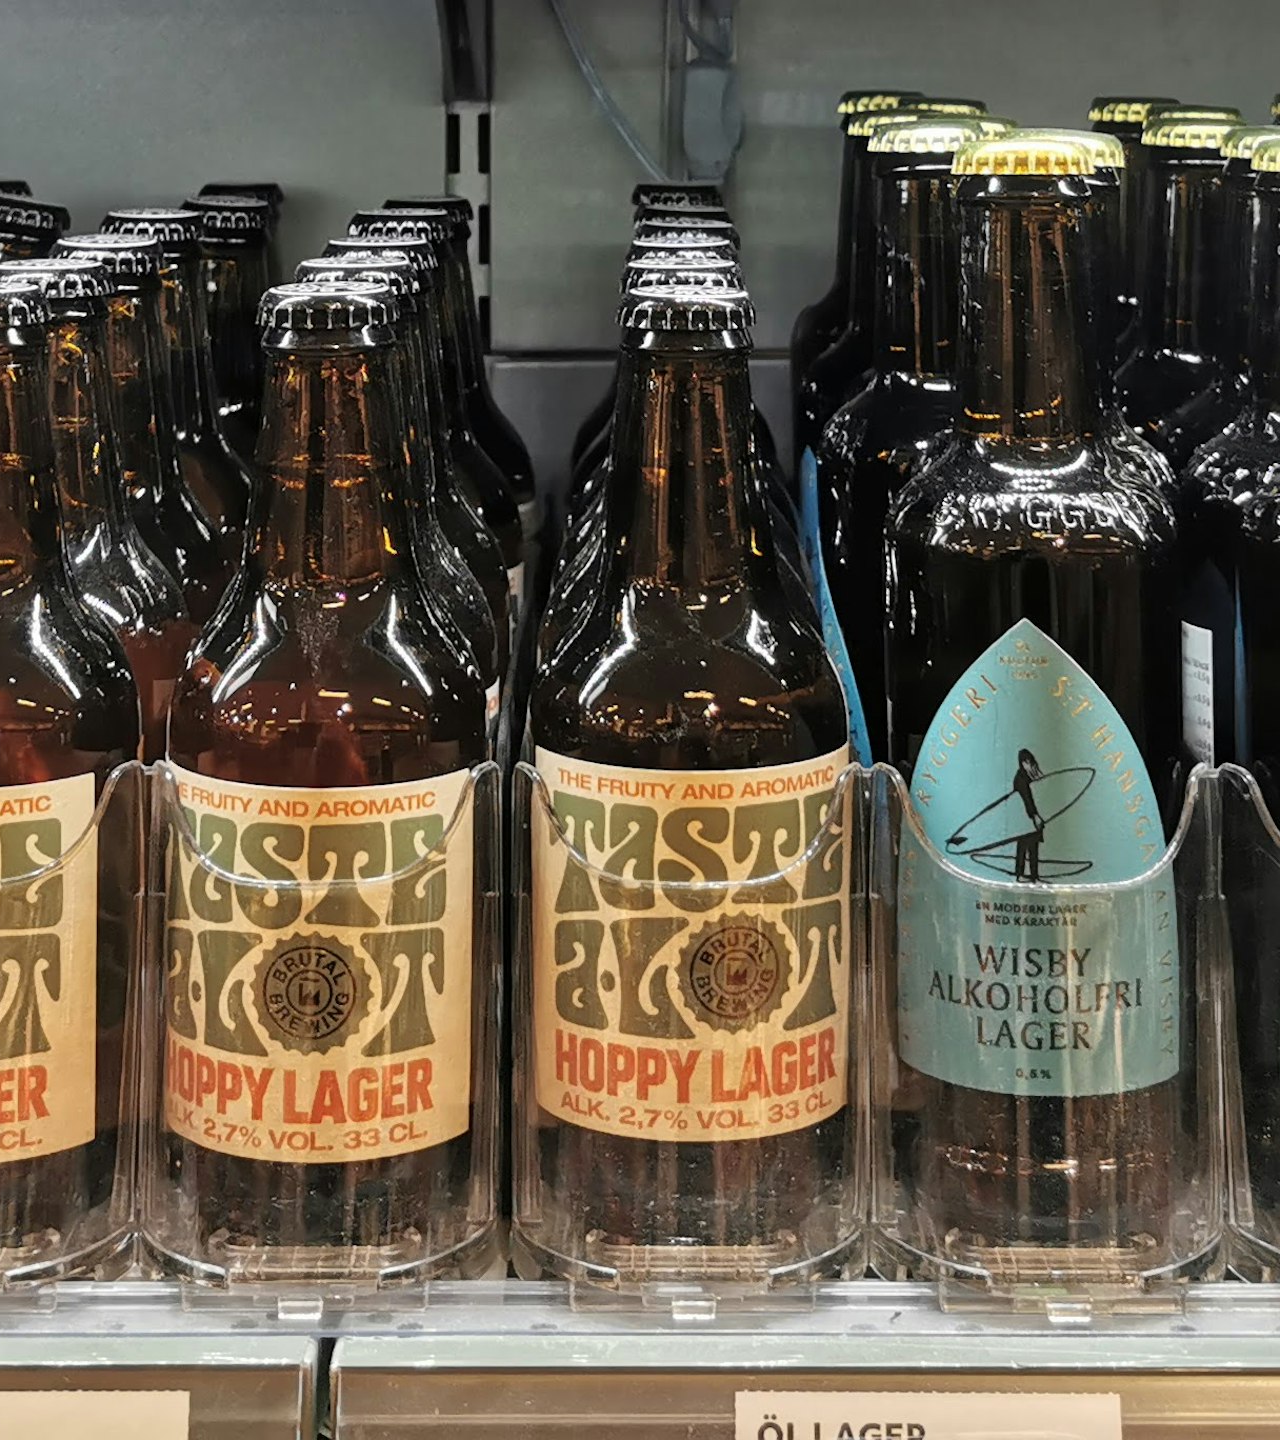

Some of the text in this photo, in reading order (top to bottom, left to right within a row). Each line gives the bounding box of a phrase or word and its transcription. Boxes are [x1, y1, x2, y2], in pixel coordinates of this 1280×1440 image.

[557, 766, 834, 800] THE FRUITY AND AROMATIC
[190, 785, 437, 818] FRUITY AND AROMATIC
[271, 948, 348, 985] BRUTAL
[973, 944, 1091, 979] WISBY
[928, 970, 1143, 1014] ALKOHOLFRI
[976, 1015, 1092, 1051] LAGER
[555, 1027, 838, 1104] HOPPY LAGER
[283, 1058, 434, 1124] LAGER
[561, 1090, 800, 1131] ALK. 2,7% VOL. 33
[7, 1127, 42, 1147] CL.
[203, 1118, 427, 1151] 2,7% VOL. 33 CL.
